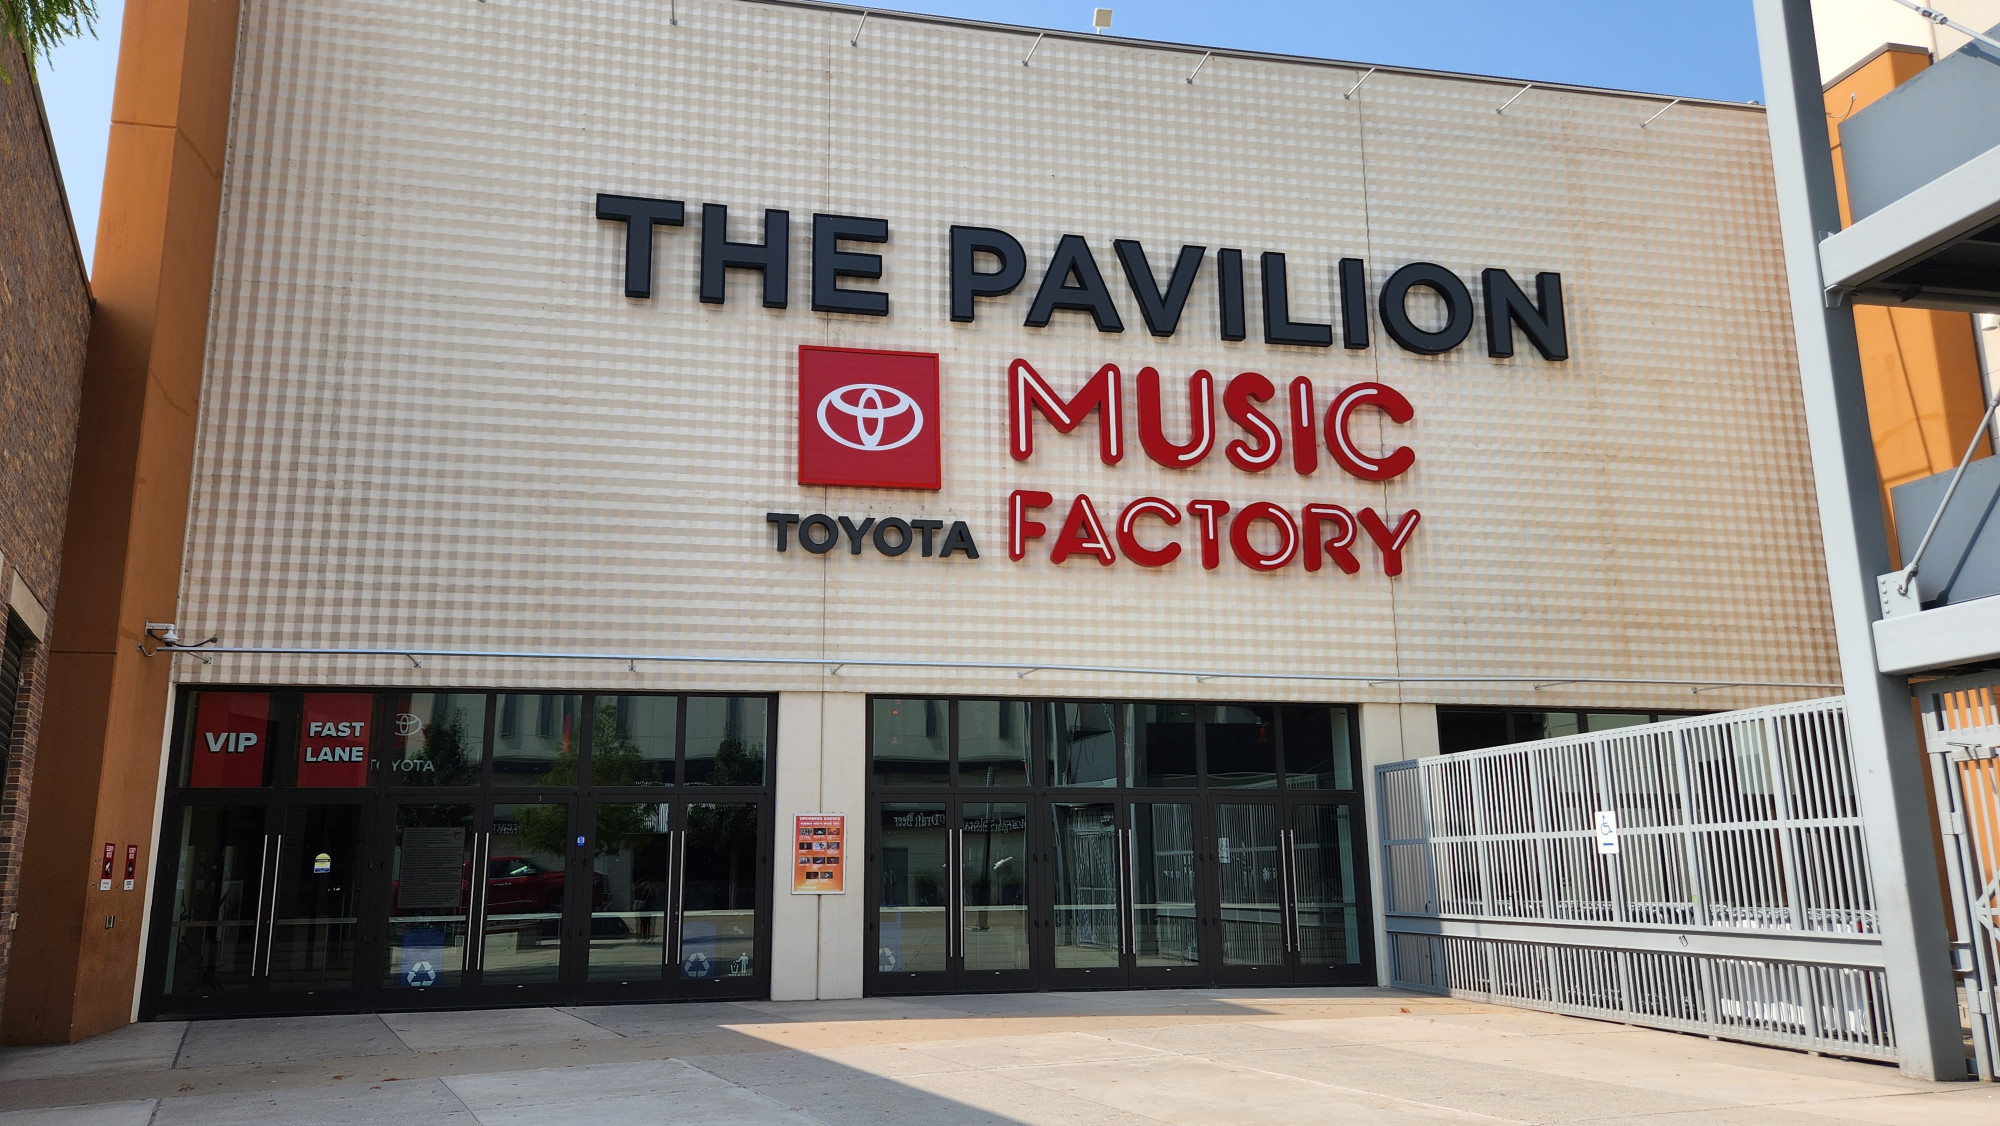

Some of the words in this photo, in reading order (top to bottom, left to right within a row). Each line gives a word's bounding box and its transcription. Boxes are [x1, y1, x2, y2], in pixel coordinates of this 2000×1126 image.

[596, 193, 889, 316] THE
[949, 225, 1568, 360] PAVILION
[1008, 358, 1416, 481] MUSIC
[766, 513, 980, 559] TOYOTA
[1008, 490, 1421, 577] FACTORY
[205, 732, 258, 753] VIP
[309, 721, 365, 737] FAST
[305, 746, 365, 762] LANE
